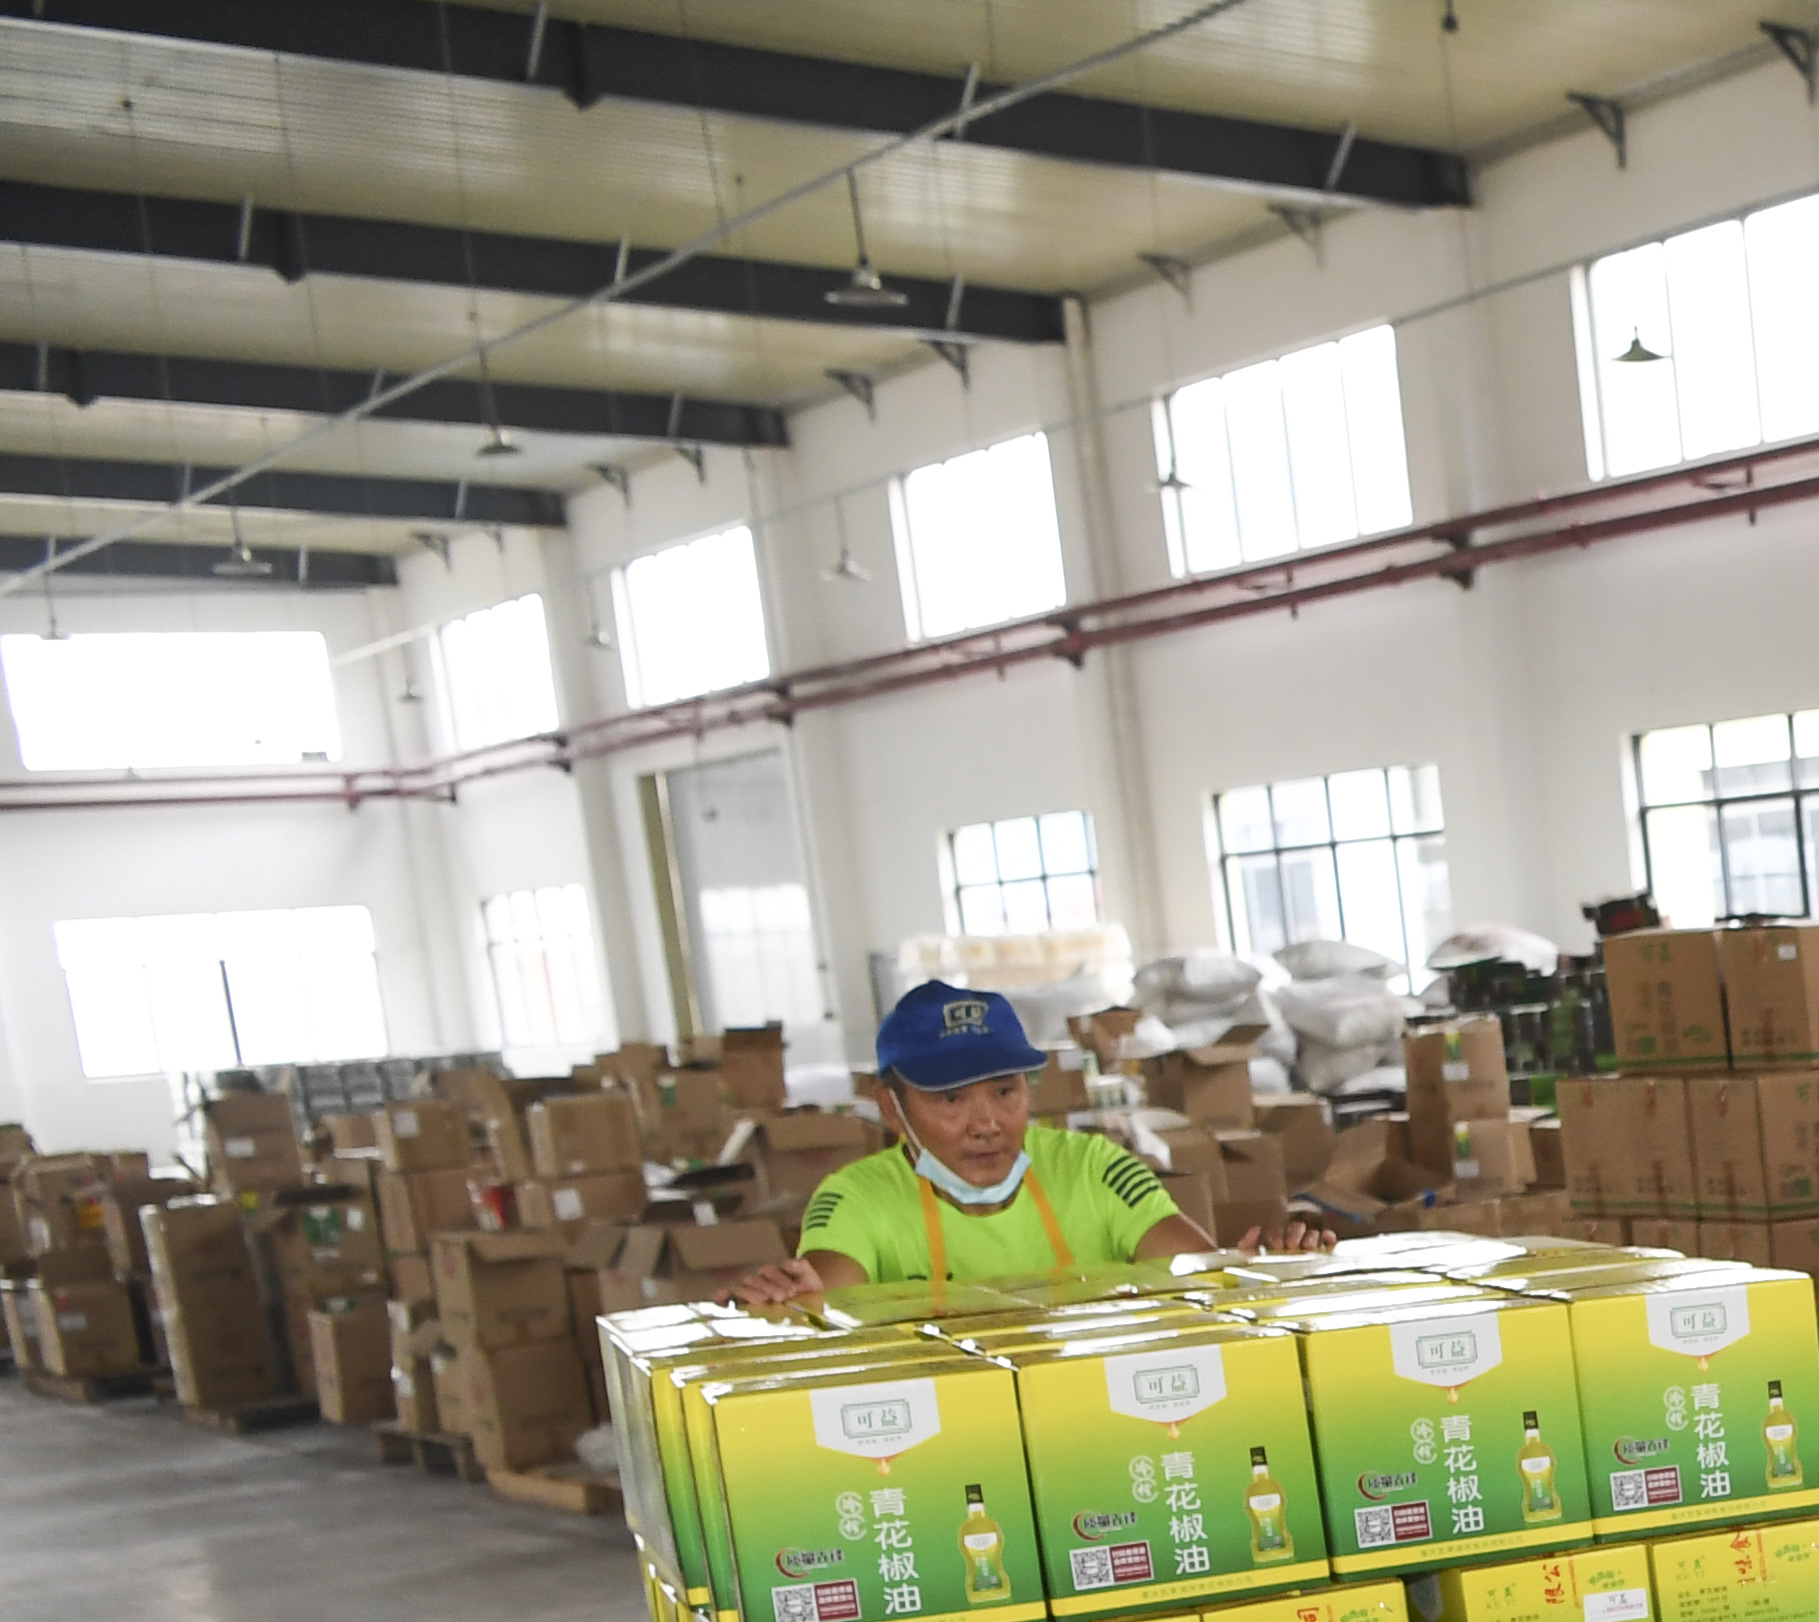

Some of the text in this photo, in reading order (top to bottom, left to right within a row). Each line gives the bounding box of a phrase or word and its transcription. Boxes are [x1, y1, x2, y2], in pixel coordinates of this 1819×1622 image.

[1430, 1339, 1466, 1359] 可益
[1683, 1311, 1715, 1329] 可益
[857, 1408, 898, 1429] 可益
[1147, 1375, 1188, 1395] 可益
[1440, 1415, 1484, 1534] 青花椒油
[1691, 1384, 1731, 1499] 青花椒油
[1160, 1452, 1210, 1575] 青花椒油
[869, 1488, 922, 1615] 青花椒油
